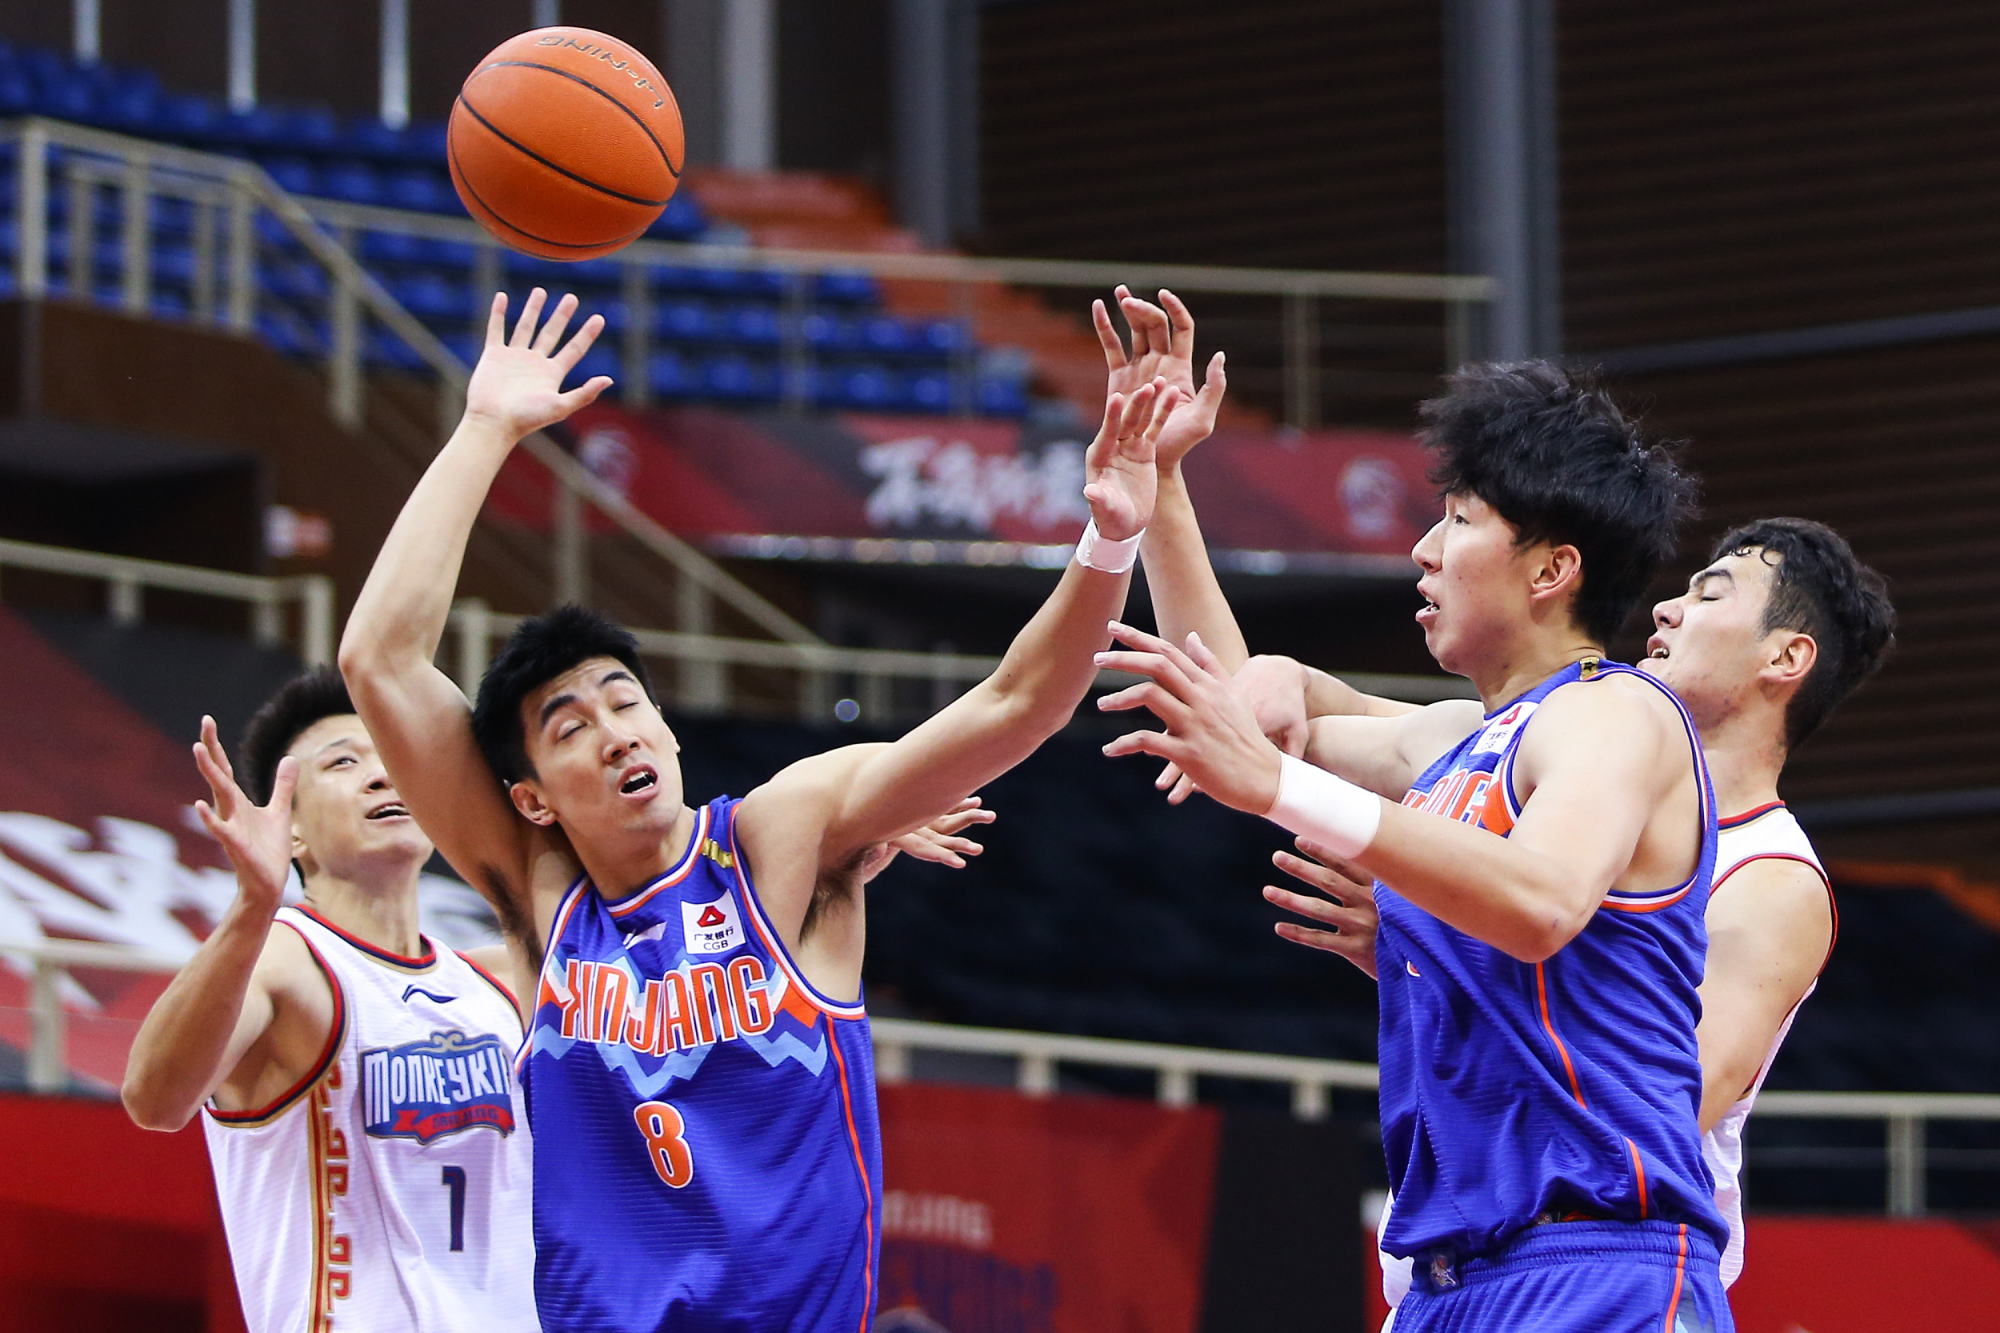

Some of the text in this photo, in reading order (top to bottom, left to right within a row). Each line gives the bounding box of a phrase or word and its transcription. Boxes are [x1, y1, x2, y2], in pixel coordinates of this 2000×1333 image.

[534, 36, 664, 109] LI-NING
[694, 925, 734, 941] 广发银行
[703, 939, 729, 951] CGB
[634, 1100, 694, 1189] 8
[442, 1165, 467, 1252] 1
